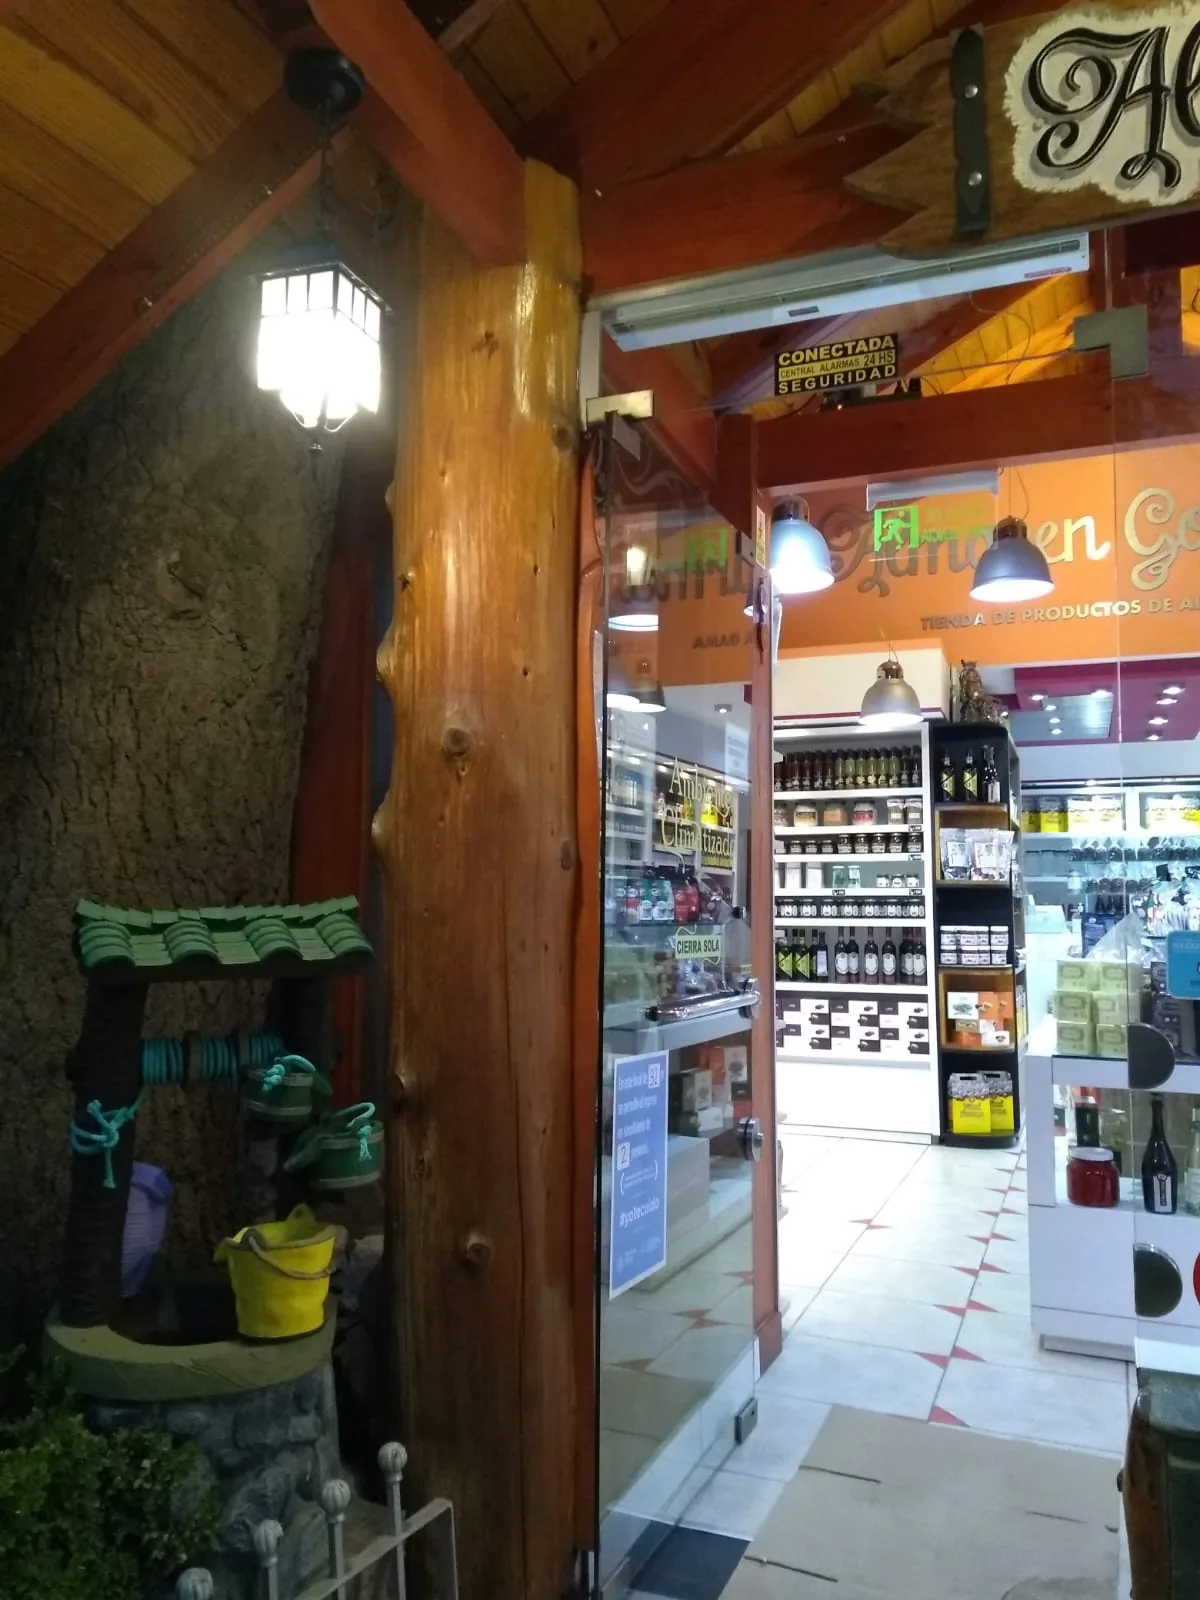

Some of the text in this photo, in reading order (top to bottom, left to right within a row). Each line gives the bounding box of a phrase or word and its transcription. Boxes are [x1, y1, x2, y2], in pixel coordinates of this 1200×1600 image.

[779, 335, 895, 366] CONECTADA
[780, 351, 894, 379] CENTRAL ALARMAS 24 HS
[778, 364, 896, 394] SEGURIDAD
[921, 611, 985, 631] TIENDA
[992, 609, 1016, 626] DE
[1021, 599, 1142, 624] PRODUCTOS
[1148, 598, 1172, 613] DE
[676, 939, 720, 954] CIERRA SOLA
